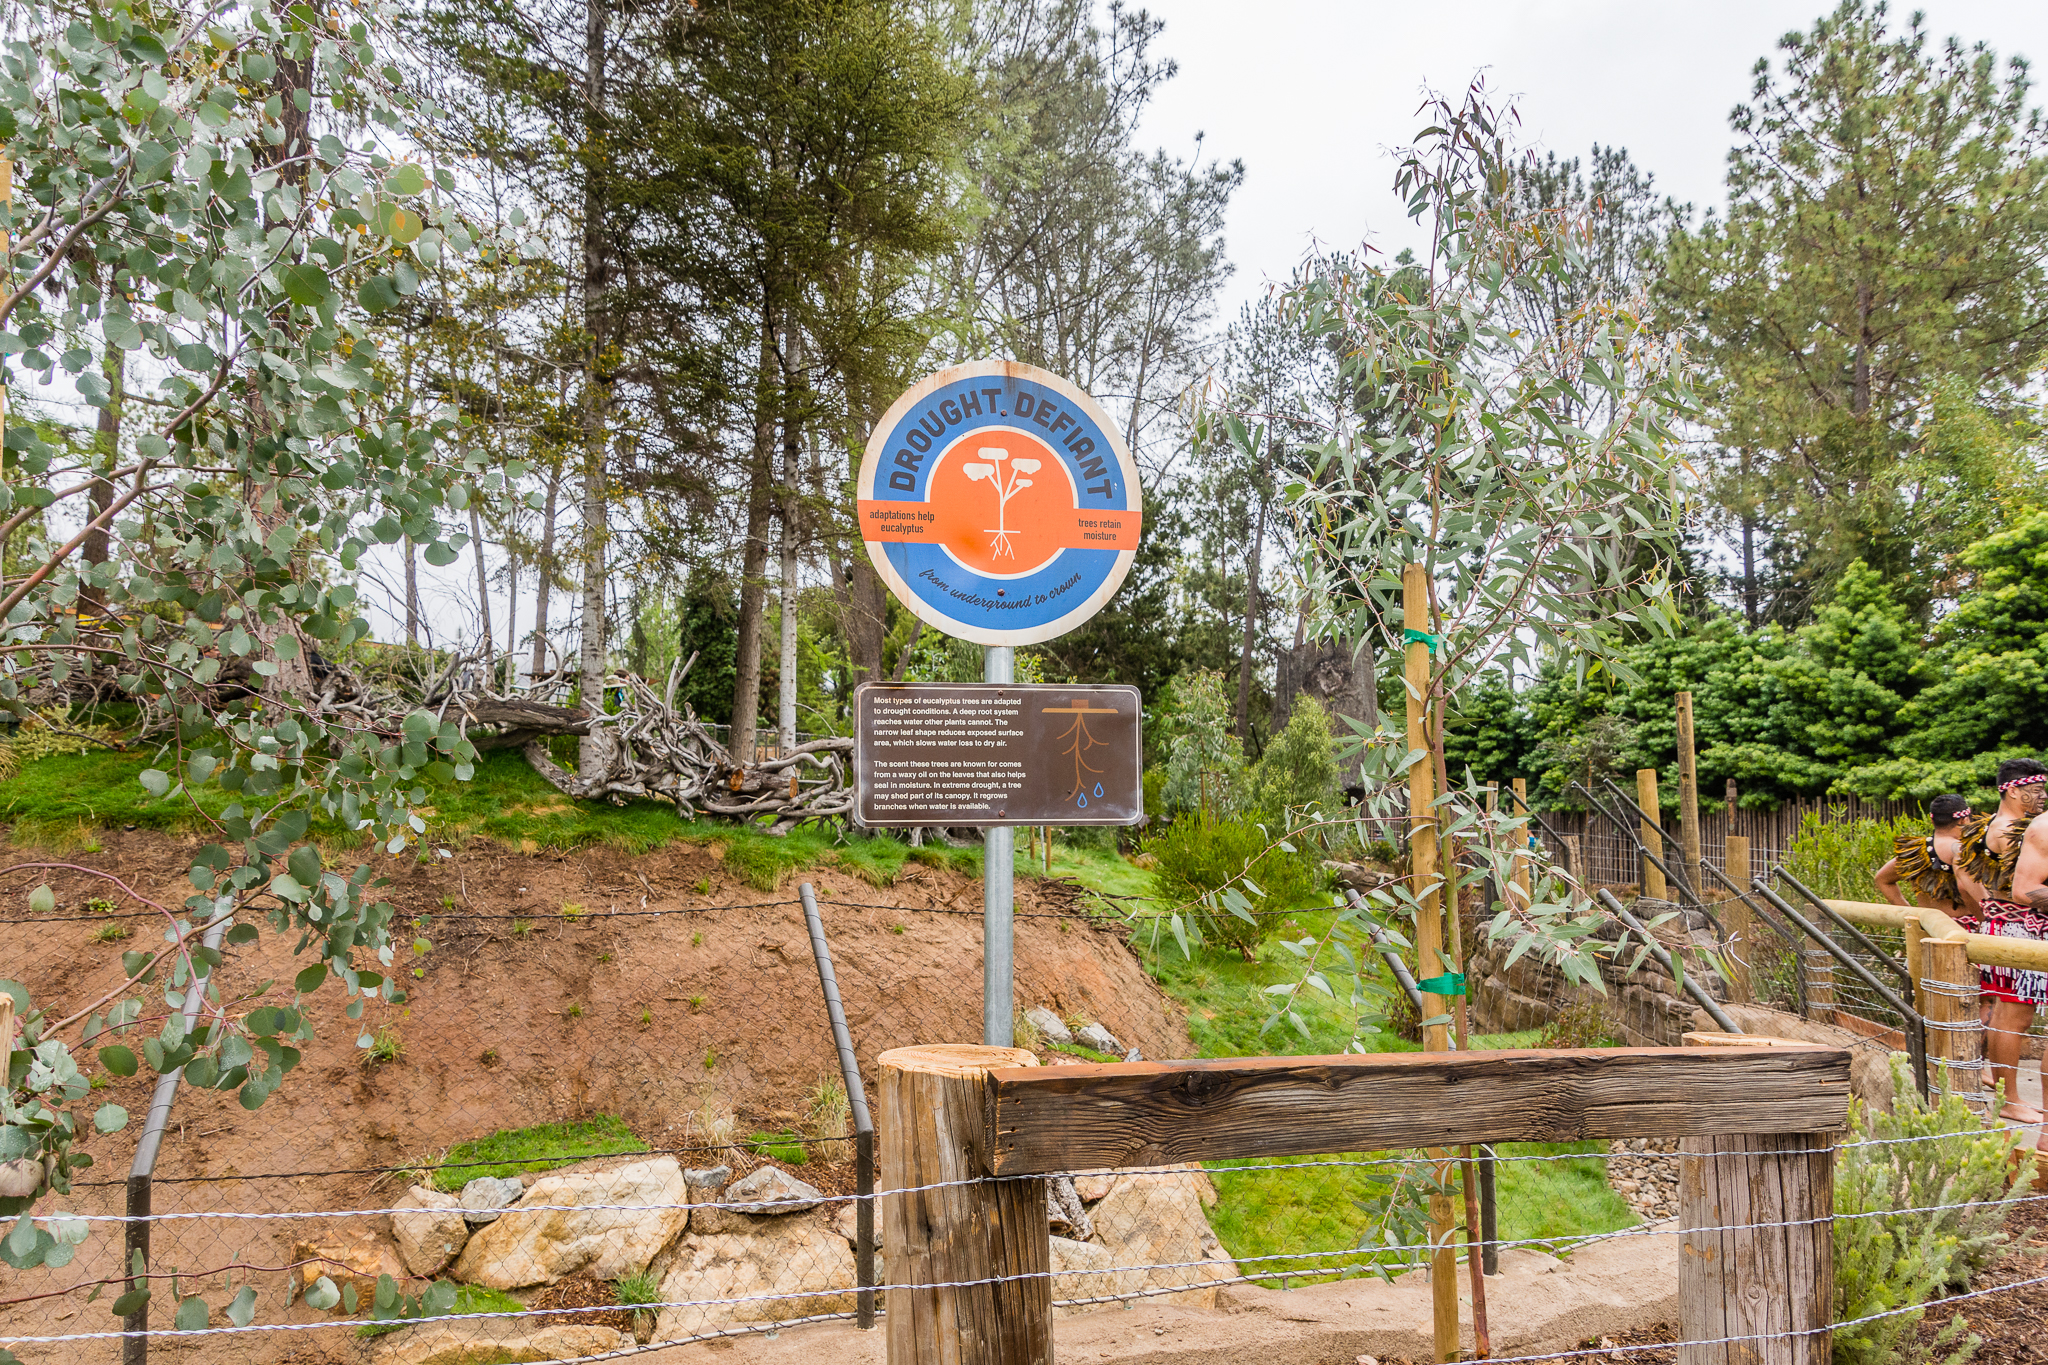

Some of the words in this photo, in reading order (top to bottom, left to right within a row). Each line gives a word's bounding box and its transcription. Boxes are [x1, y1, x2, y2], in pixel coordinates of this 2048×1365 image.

[889, 389, 1002, 492] DROUGHT
[1014, 392, 1112, 499] DEFIANT
[870, 510, 916, 522] adaptations
[918, 511, 934, 523] help
[1078, 518, 1098, 528] trees
[1100, 520, 1122, 528] retain
[881, 523, 924, 535] eucalyptus
[1084, 531, 1116, 540] moisture
[918, 568, 949, 592] from
[950, 588, 1032, 612] underground
[1035, 594, 1048, 605] to
[1050, 572, 1082, 599] crown
[893, 697, 912, 706] types
[922, 697, 961, 706] eucalyptus
[993, 698, 1021, 706] adapted
[882, 707, 911, 716] drought
[959, 708, 977, 716] deep
[994, 708, 1019, 717] system
[873, 718, 902, 726] reaches
[944, 718, 966, 727] plants
[915, 729, 937, 737] shape
[967, 729, 997, 737] exposed
[983, 740, 995, 748] dry
[1007, 771, 1026, 780] helps
[971, 781, 1001, 790] drought,
[910, 792, 924, 800] part
